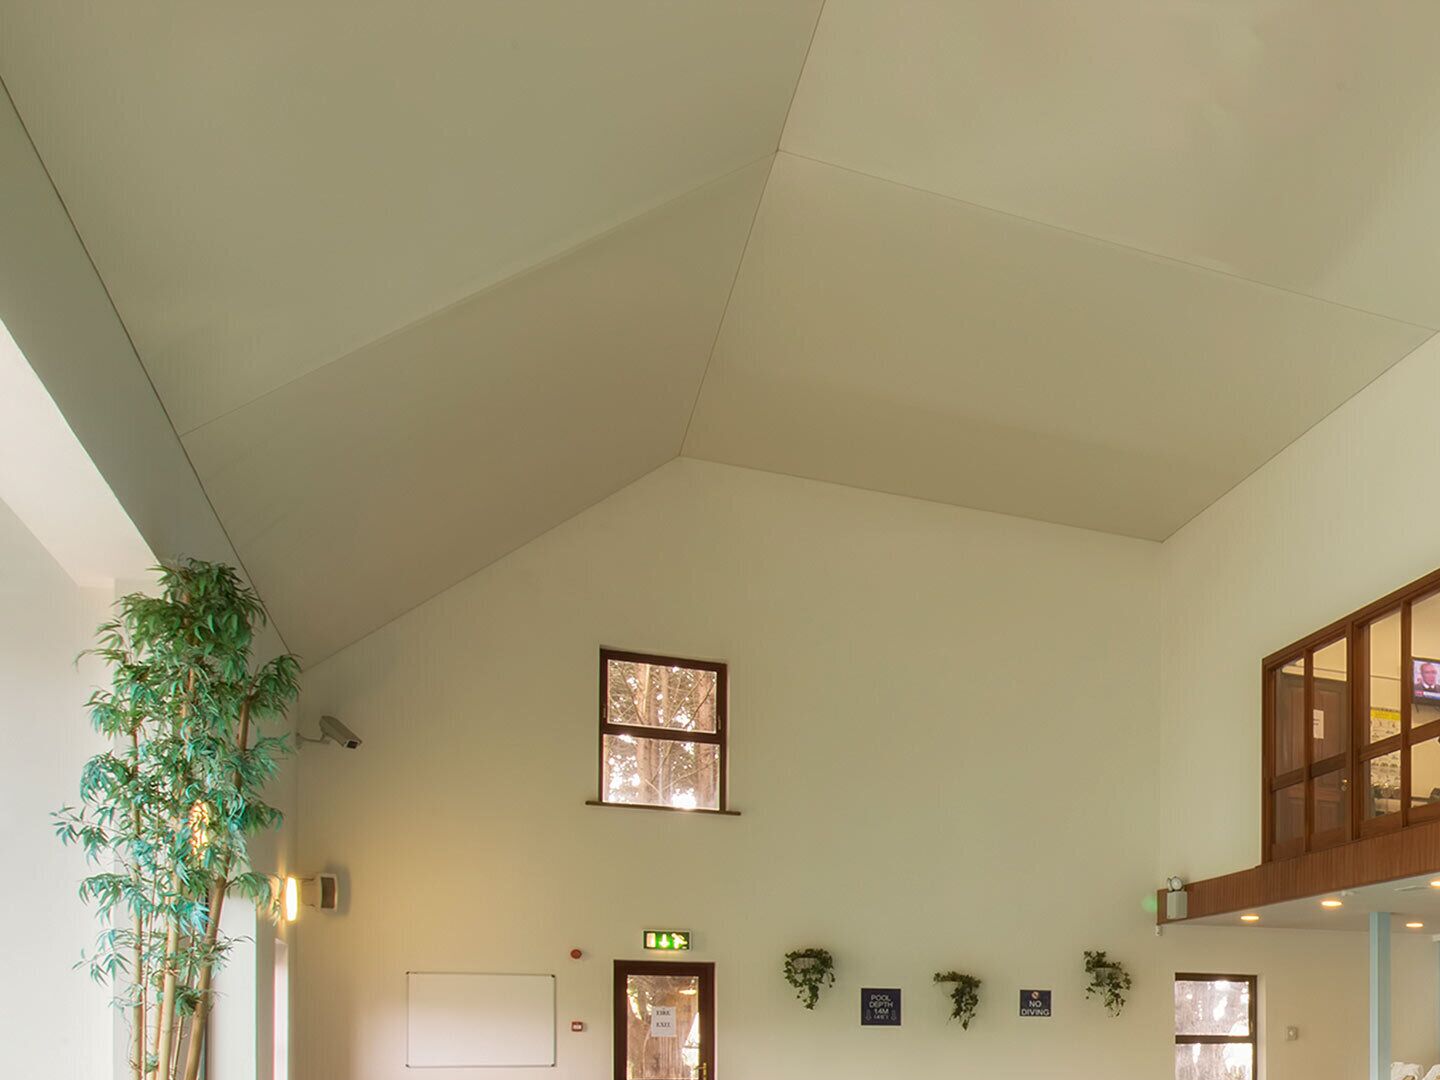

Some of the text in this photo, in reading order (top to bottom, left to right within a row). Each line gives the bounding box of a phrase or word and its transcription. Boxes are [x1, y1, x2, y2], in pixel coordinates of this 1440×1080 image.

[870, 994, 892, 1002] POOL
[868, 1001, 894, 1009] DEPTH
[1028, 1000, 1042, 1008] NO
[1021, 1008, 1050, 1017] DIVING
